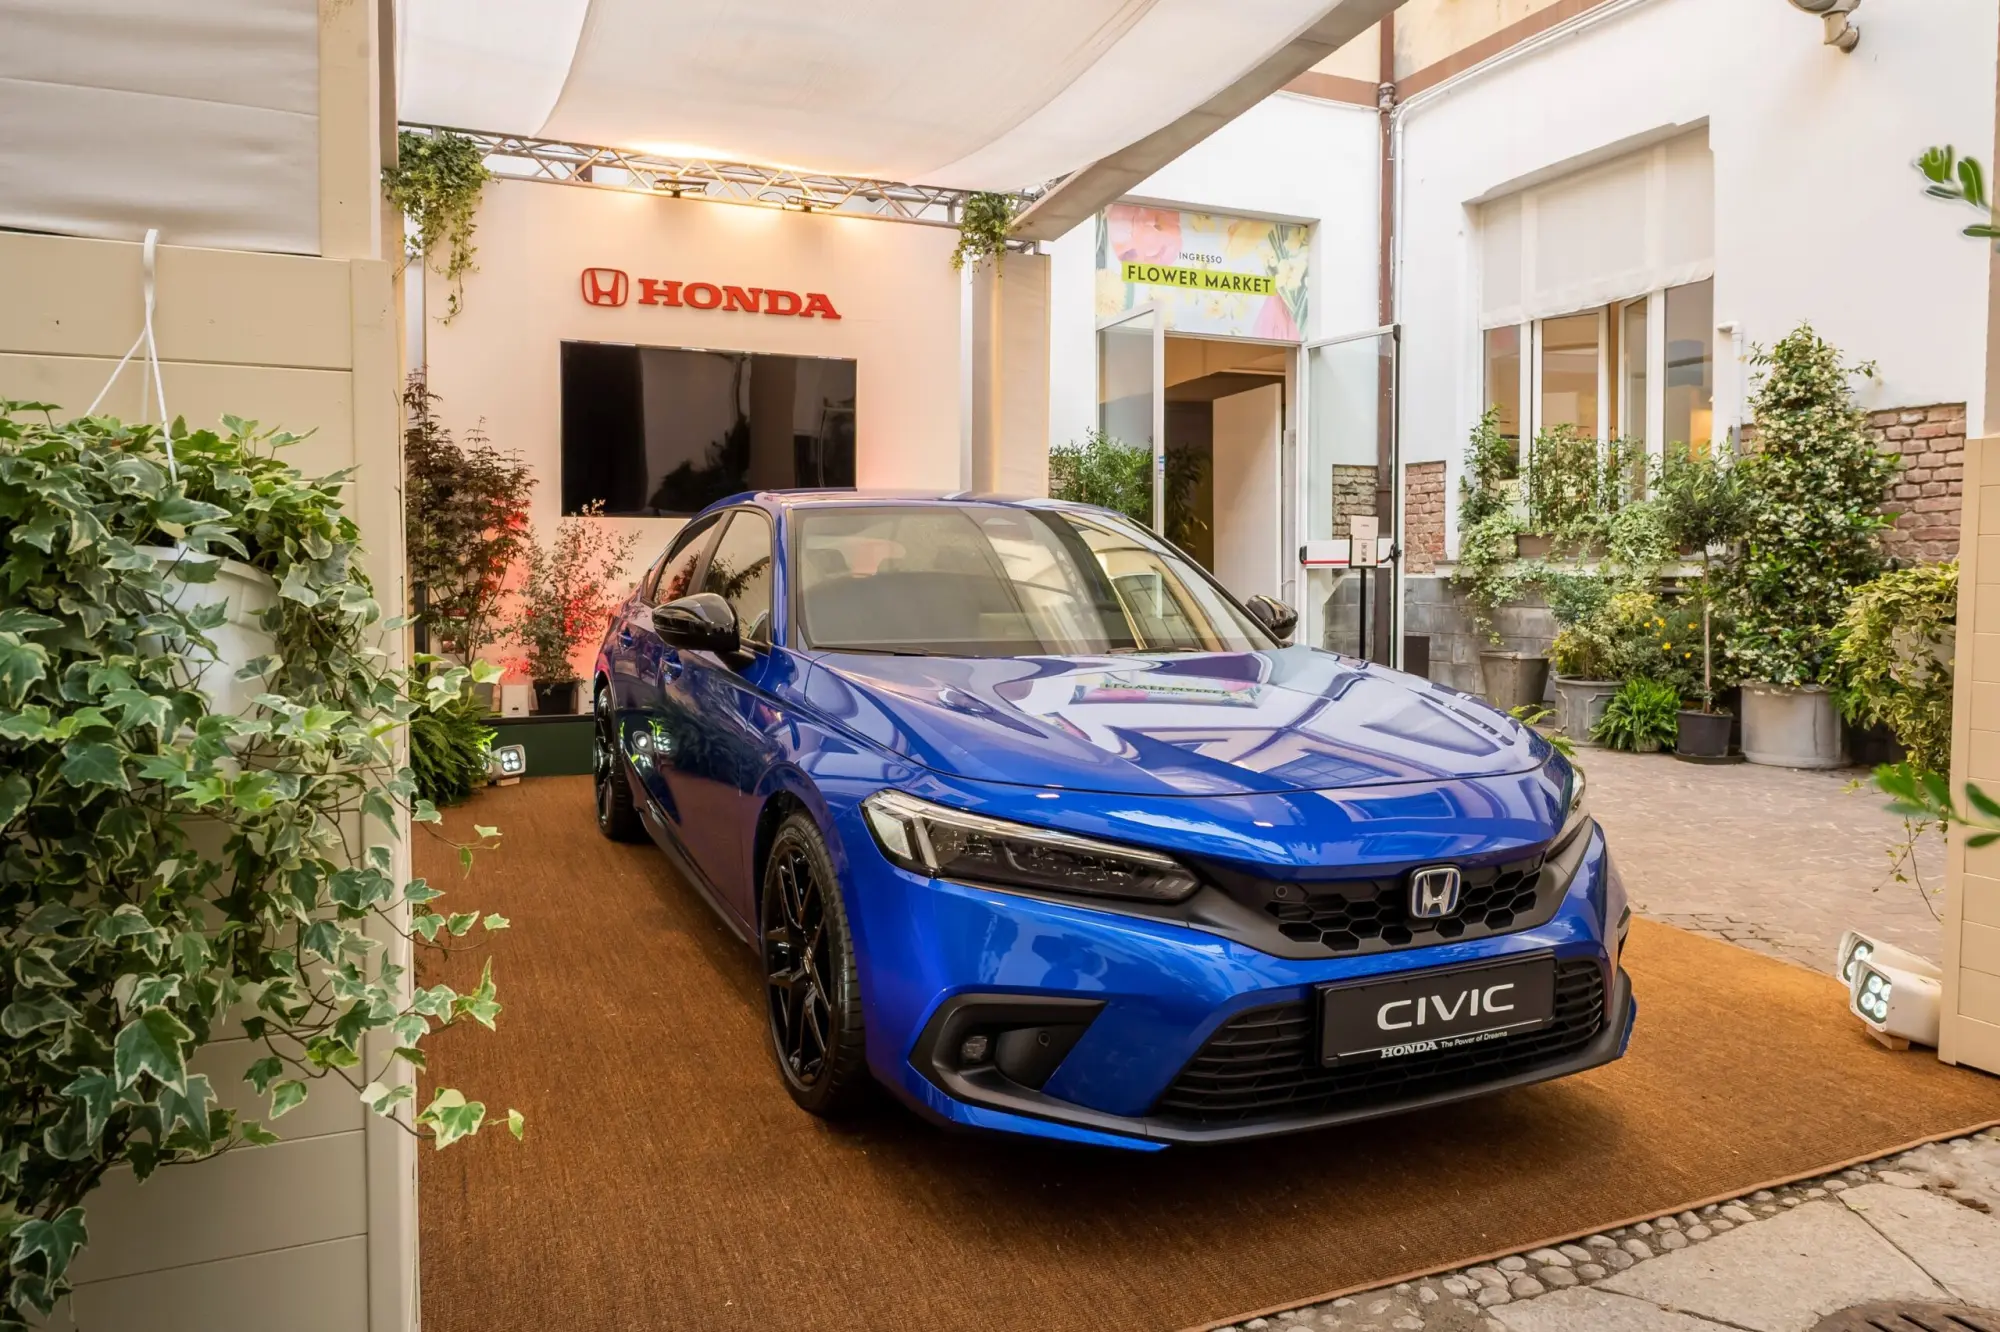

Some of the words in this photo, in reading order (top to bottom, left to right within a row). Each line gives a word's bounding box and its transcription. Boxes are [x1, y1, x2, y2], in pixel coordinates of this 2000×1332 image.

[1178, 252, 1223, 264] INGRESSO
[1127, 265, 1198, 286] FLOWER
[1205, 274, 1271, 293] MARKET
[638, 278, 842, 319] HONDA
[1377, 983, 1514, 1030] CIVIC
[1380, 1041, 1438, 1058] HONDA
[1441, 1040, 1454, 1048] The
[1454, 1037, 1475, 1047] Power
[1476, 1034, 1484, 1042] of
[1484, 1030, 1508, 1040] Dreams
